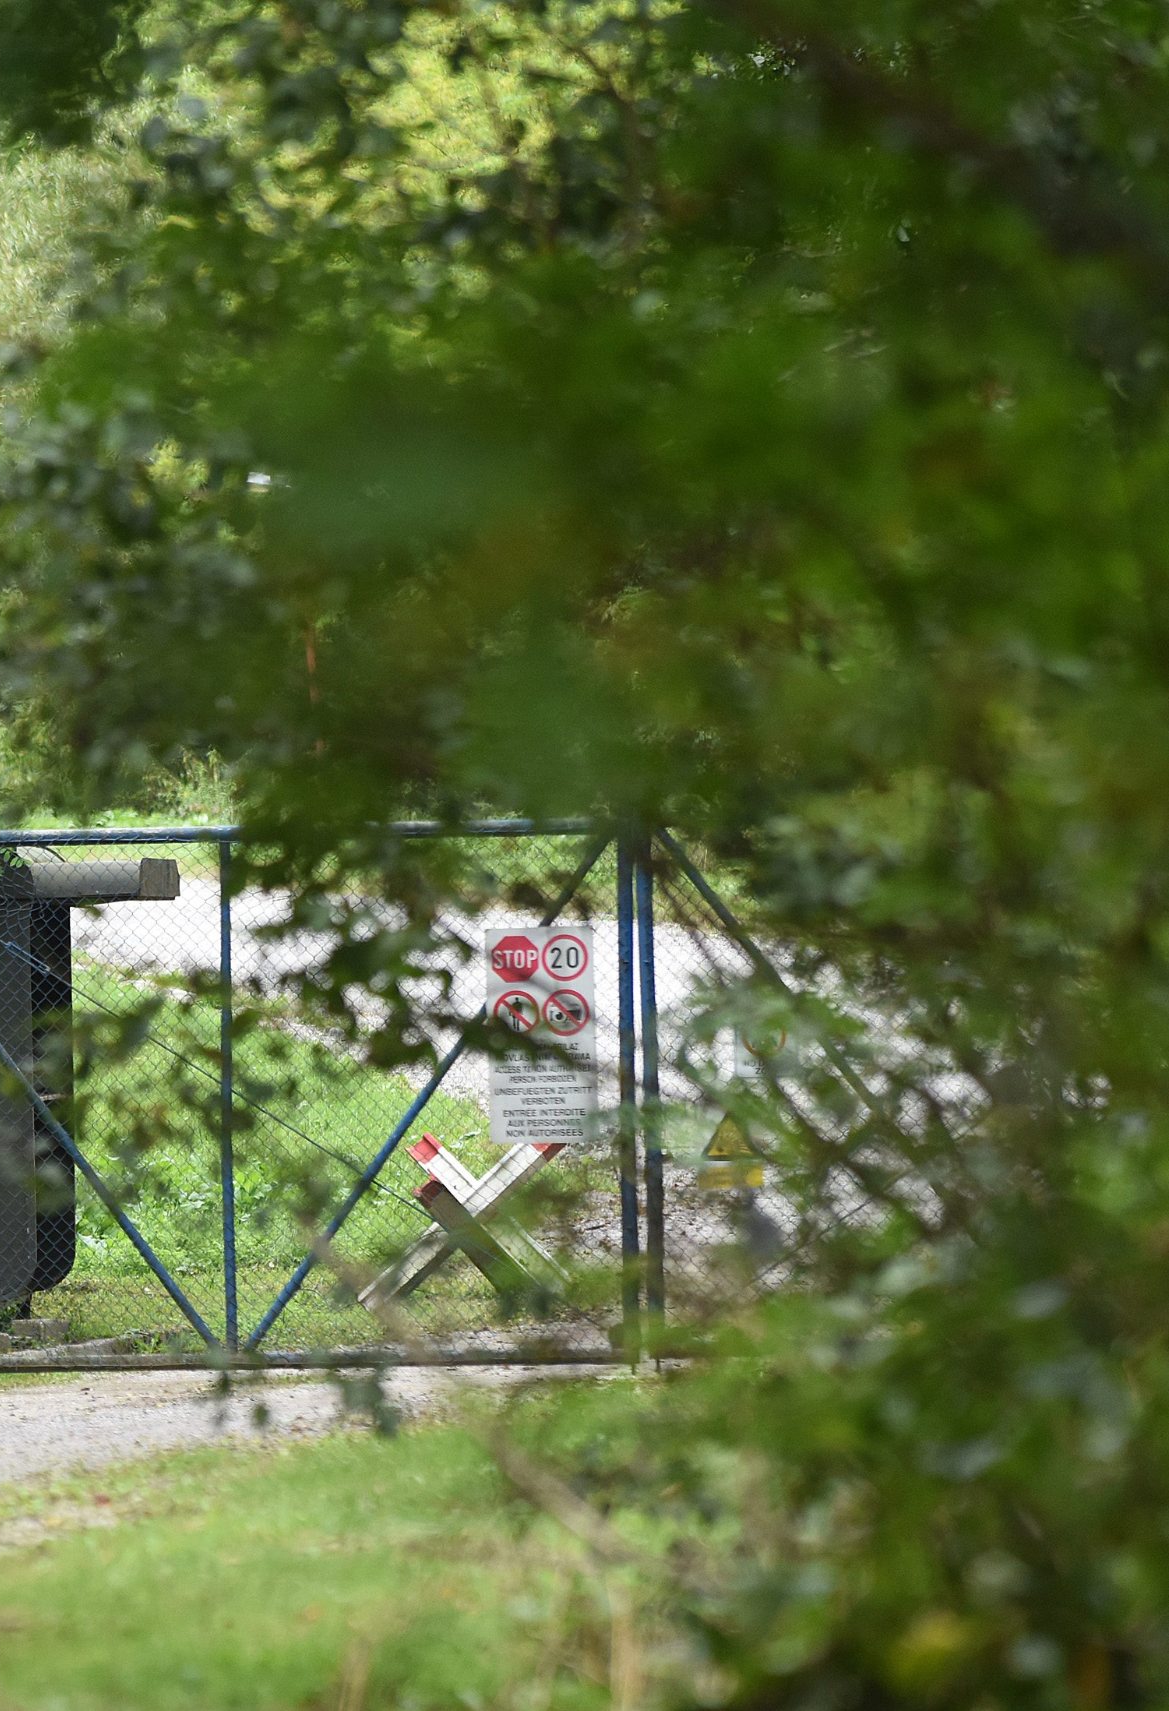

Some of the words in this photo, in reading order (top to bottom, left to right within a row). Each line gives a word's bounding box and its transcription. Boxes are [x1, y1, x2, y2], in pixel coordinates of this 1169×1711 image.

[493, 949, 537, 970] STOP
[551, 946, 579, 969] 20
[558, 1086, 593, 1095] ZUTRITT
[521, 1096, 565, 1106] VERBOTEN
[539, 1108, 586, 1117] INTERDITE
[507, 1119, 524, 1128] AUX
[506, 1129, 525, 1138] NON
